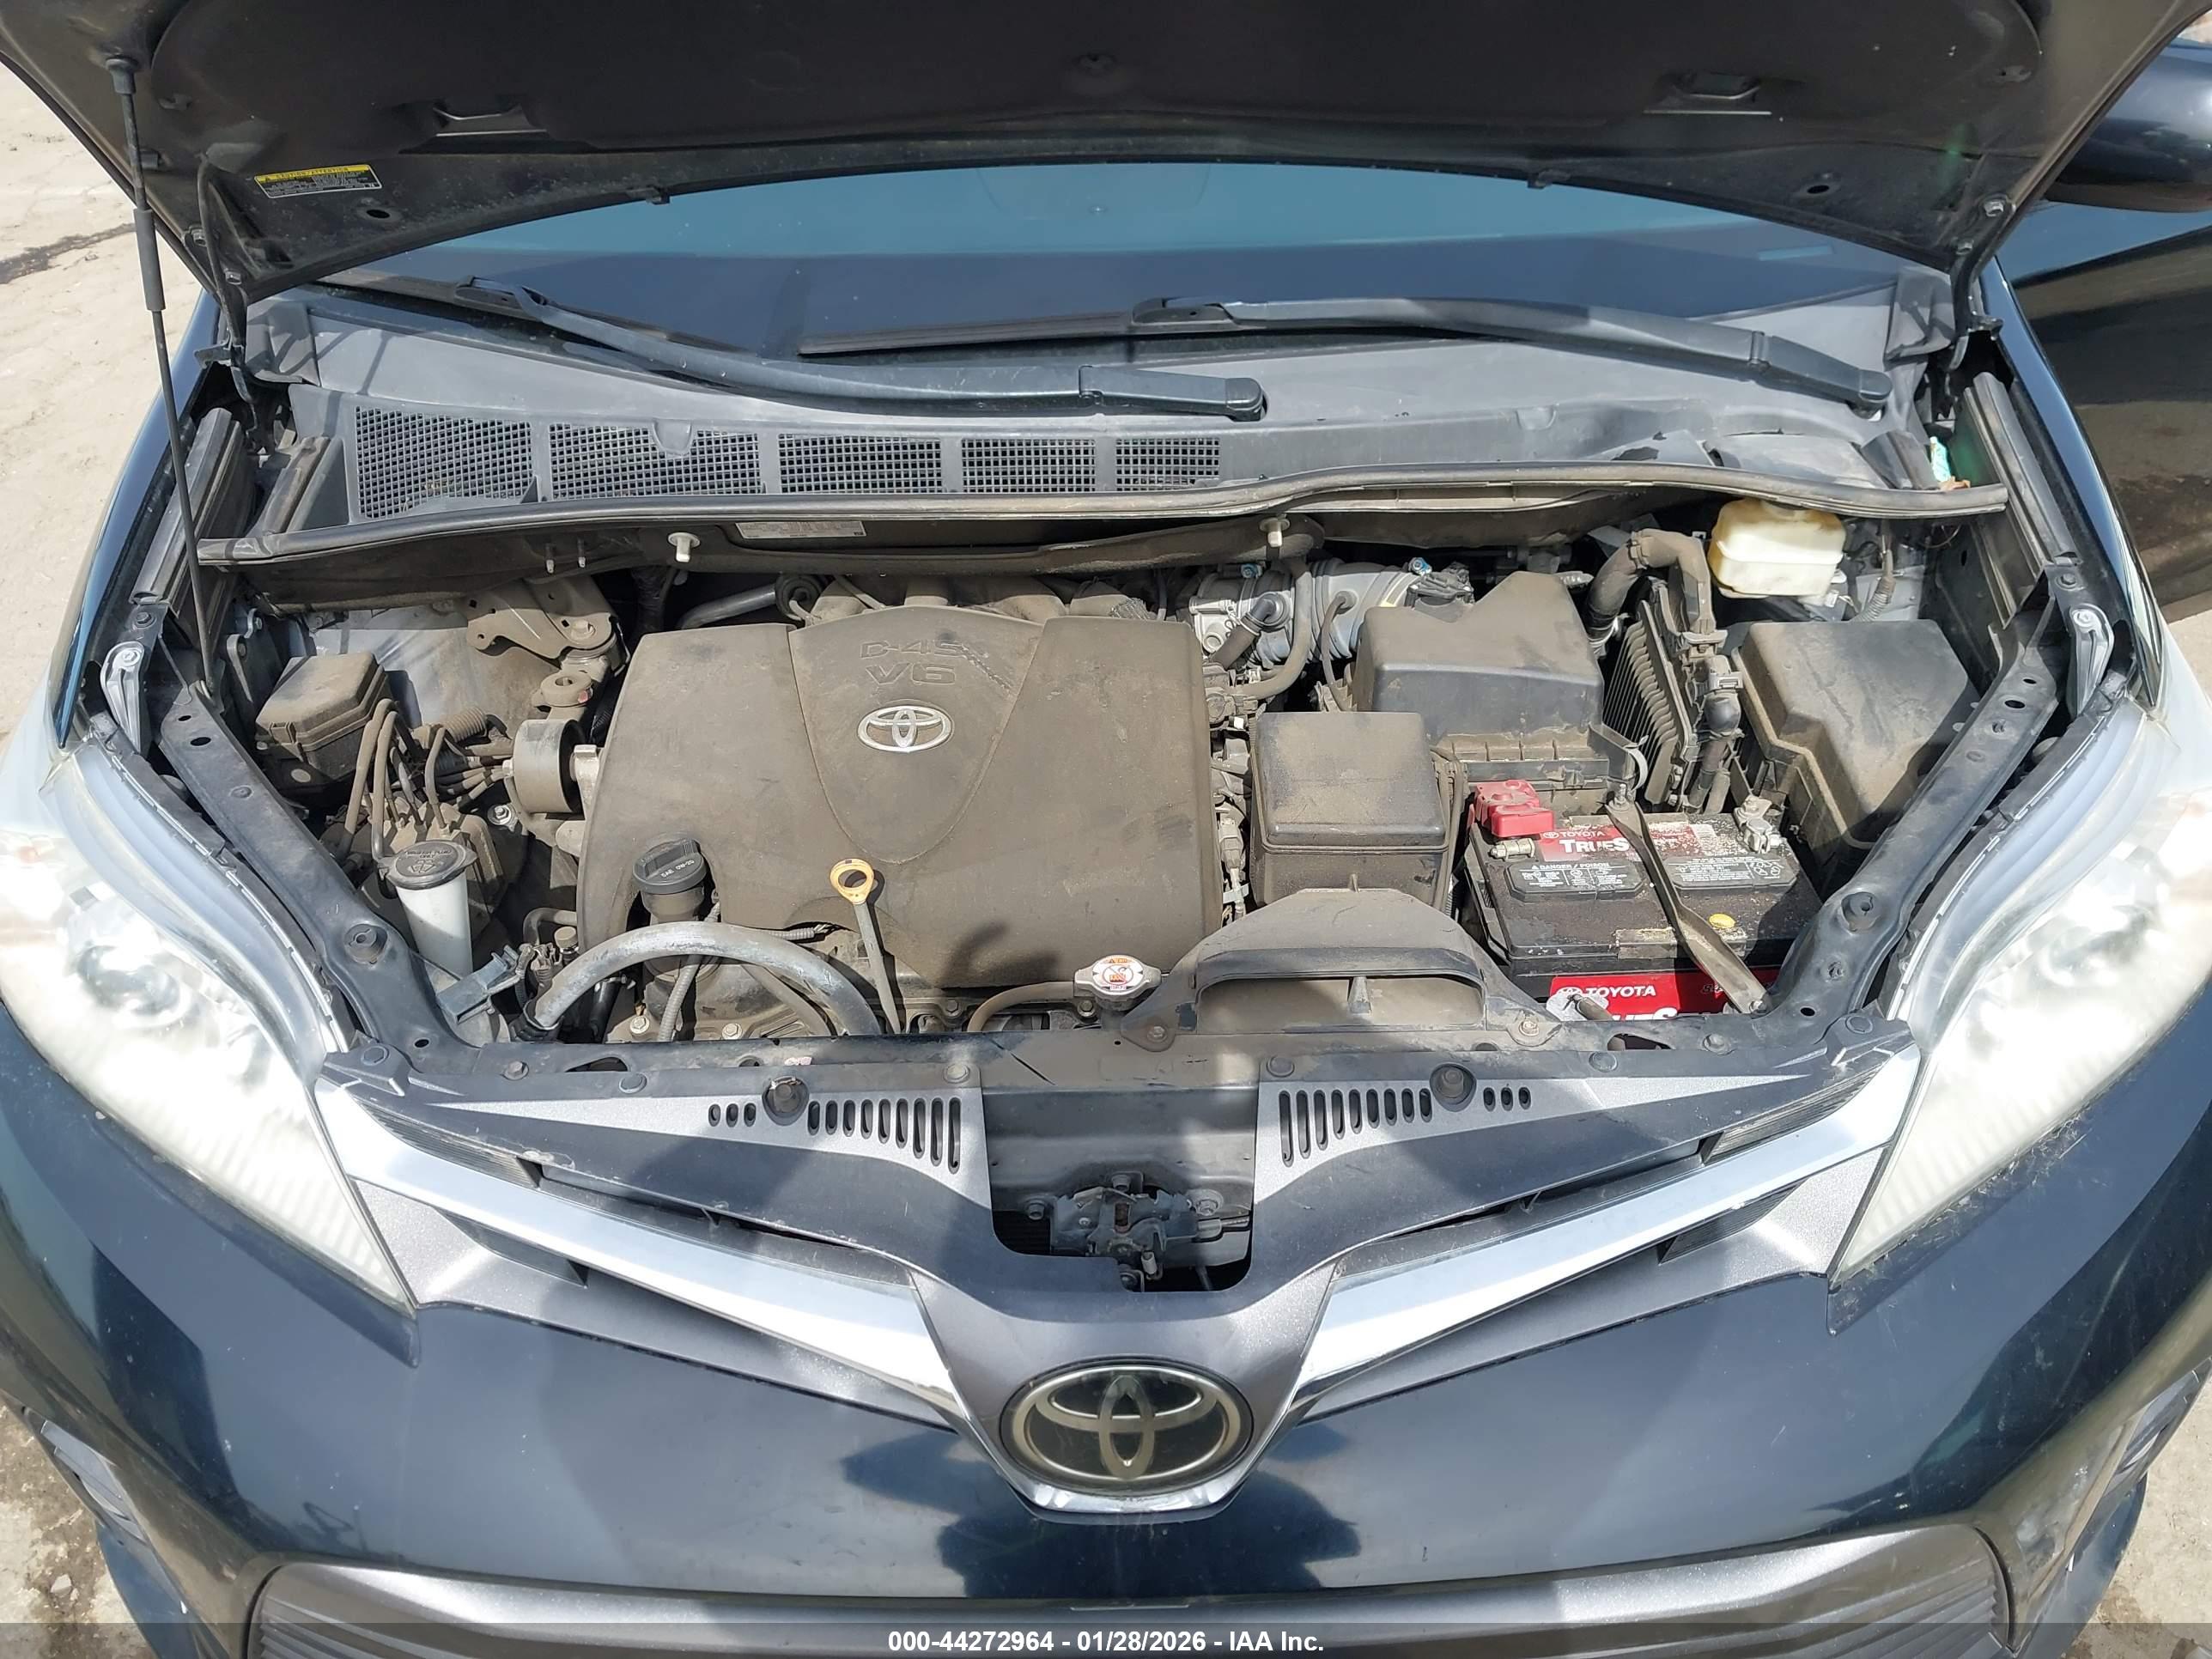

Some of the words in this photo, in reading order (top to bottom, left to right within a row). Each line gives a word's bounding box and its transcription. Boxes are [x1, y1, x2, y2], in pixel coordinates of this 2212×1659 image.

[865, 661, 956, 685] V6
[1559, 830, 1606, 840] TOYOTA
[1585, 985, 1656, 998] TOYOTA
